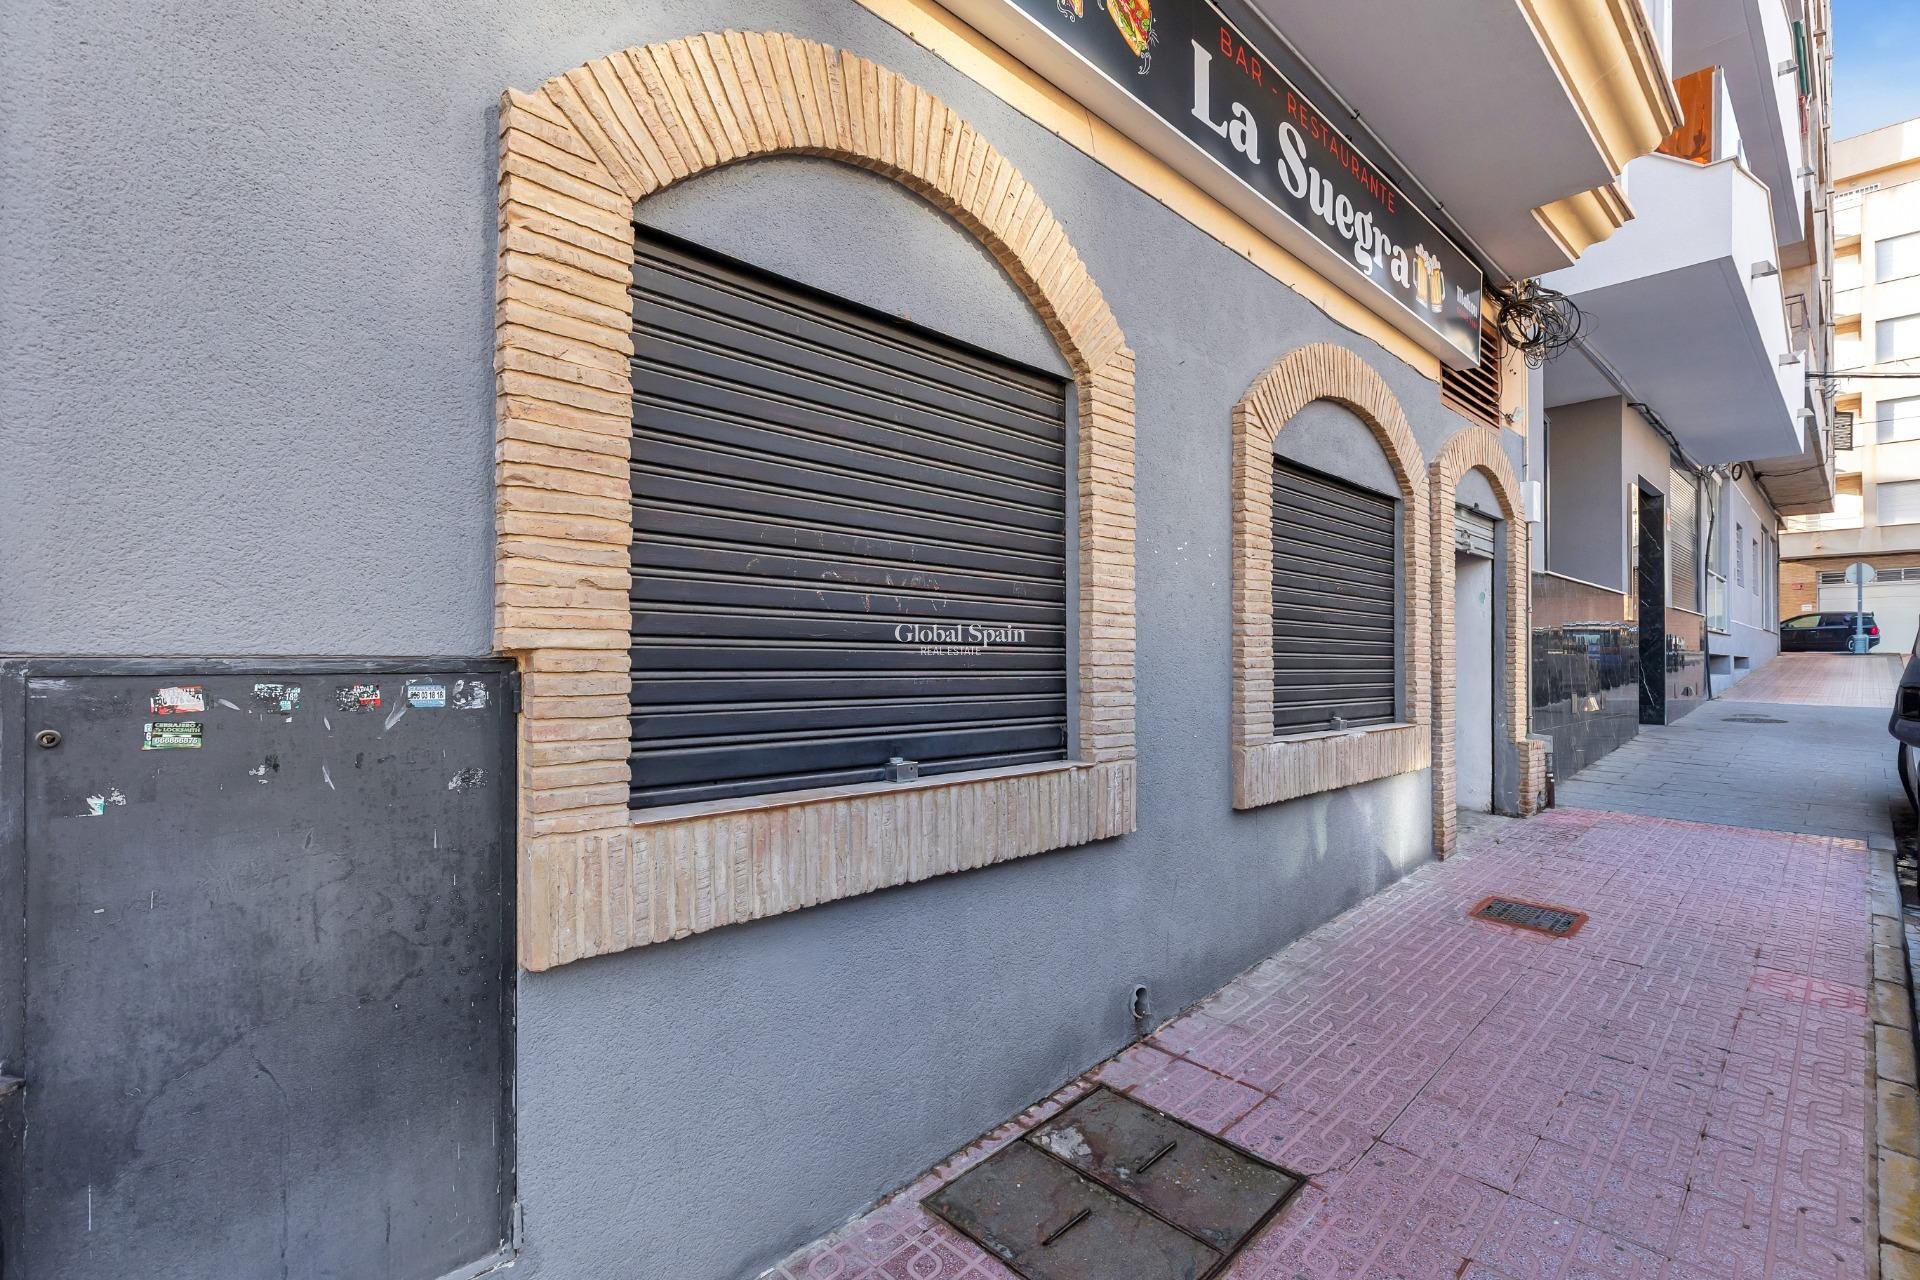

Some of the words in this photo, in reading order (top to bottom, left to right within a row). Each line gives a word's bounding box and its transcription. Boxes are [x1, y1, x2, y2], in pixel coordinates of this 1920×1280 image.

[1191, 39, 1261, 165] La
[1278, 121, 1411, 288] Suegra
[1219, 26, 1262, 87] BAR
[1287, 92, 1397, 214] RESTAURANTE
